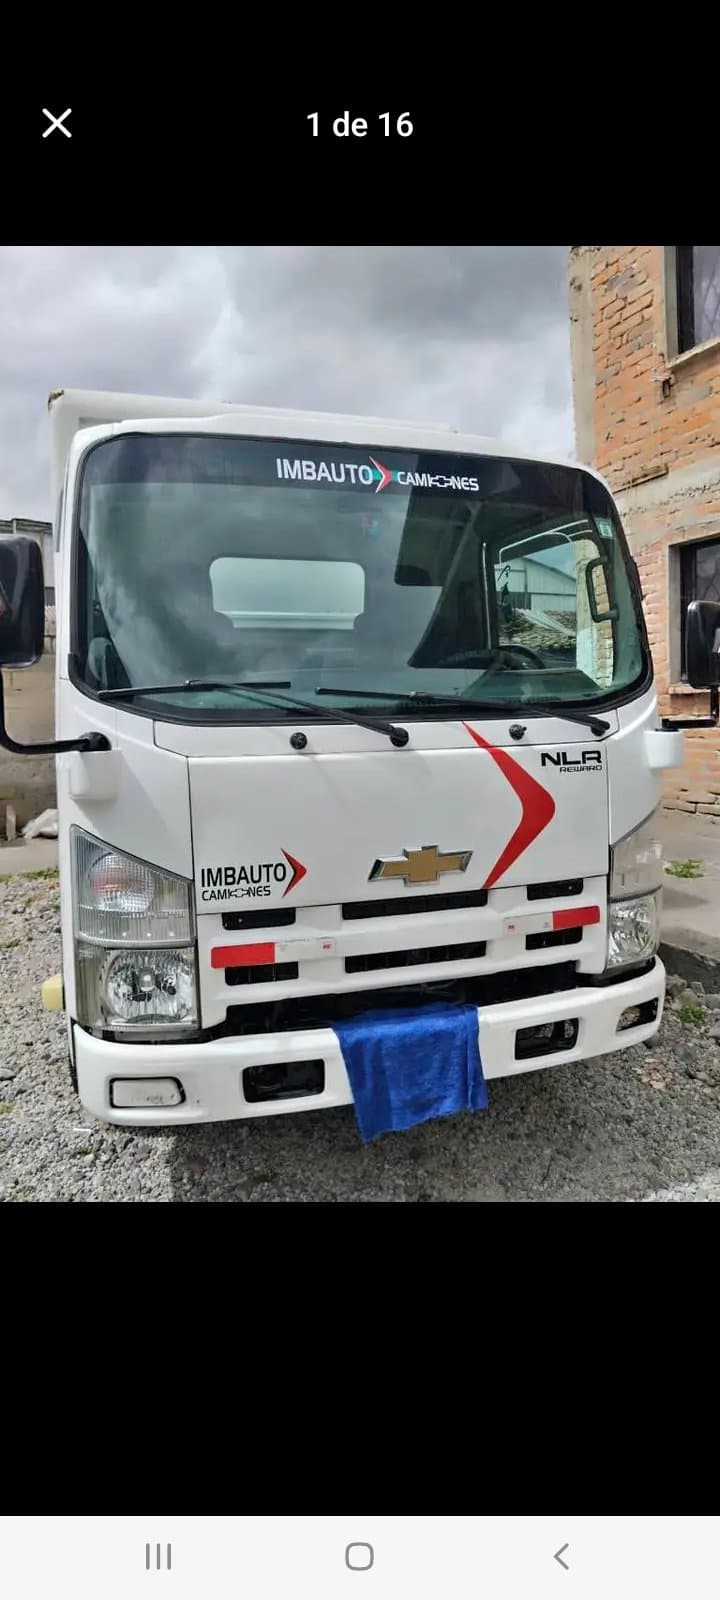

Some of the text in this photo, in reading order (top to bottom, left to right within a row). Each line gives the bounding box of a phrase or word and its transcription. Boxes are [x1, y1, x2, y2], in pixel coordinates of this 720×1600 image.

[276, 458, 373, 485] IMBAUTO
[541, 750, 602, 767] NLR
[560, 765, 602, 773] REWARD
[201, 863, 287, 887] IMBAUTO
